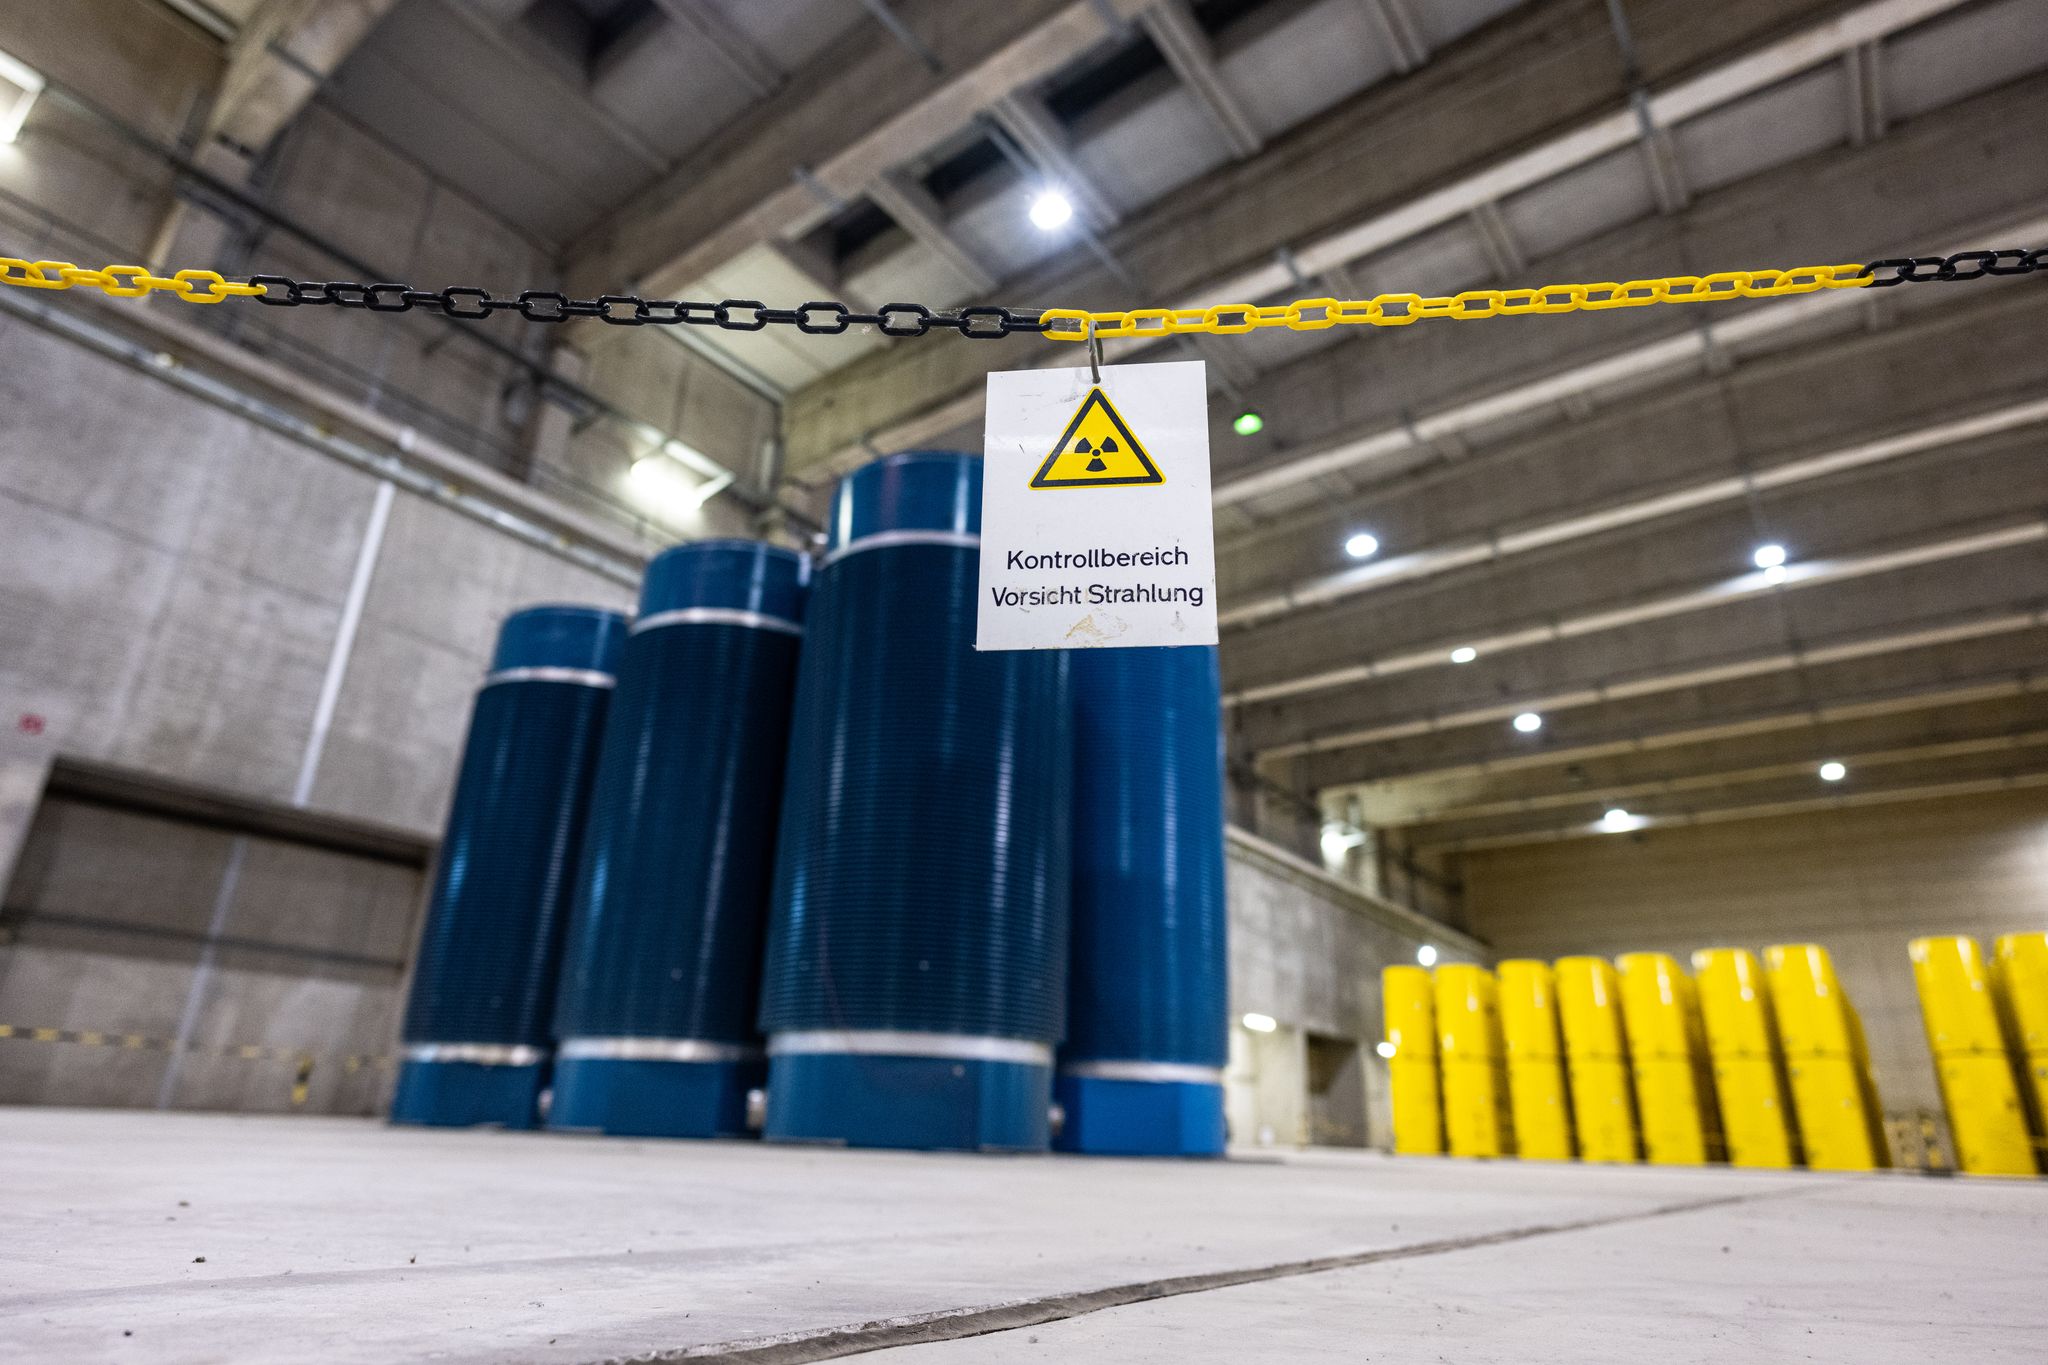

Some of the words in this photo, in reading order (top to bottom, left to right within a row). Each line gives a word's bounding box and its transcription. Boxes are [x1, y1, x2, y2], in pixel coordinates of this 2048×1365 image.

[1007, 546, 1189, 570] Kontrollbereich
[992, 585, 1082, 607] Vorsicht
[1088, 583, 1203, 607] Strahlung
